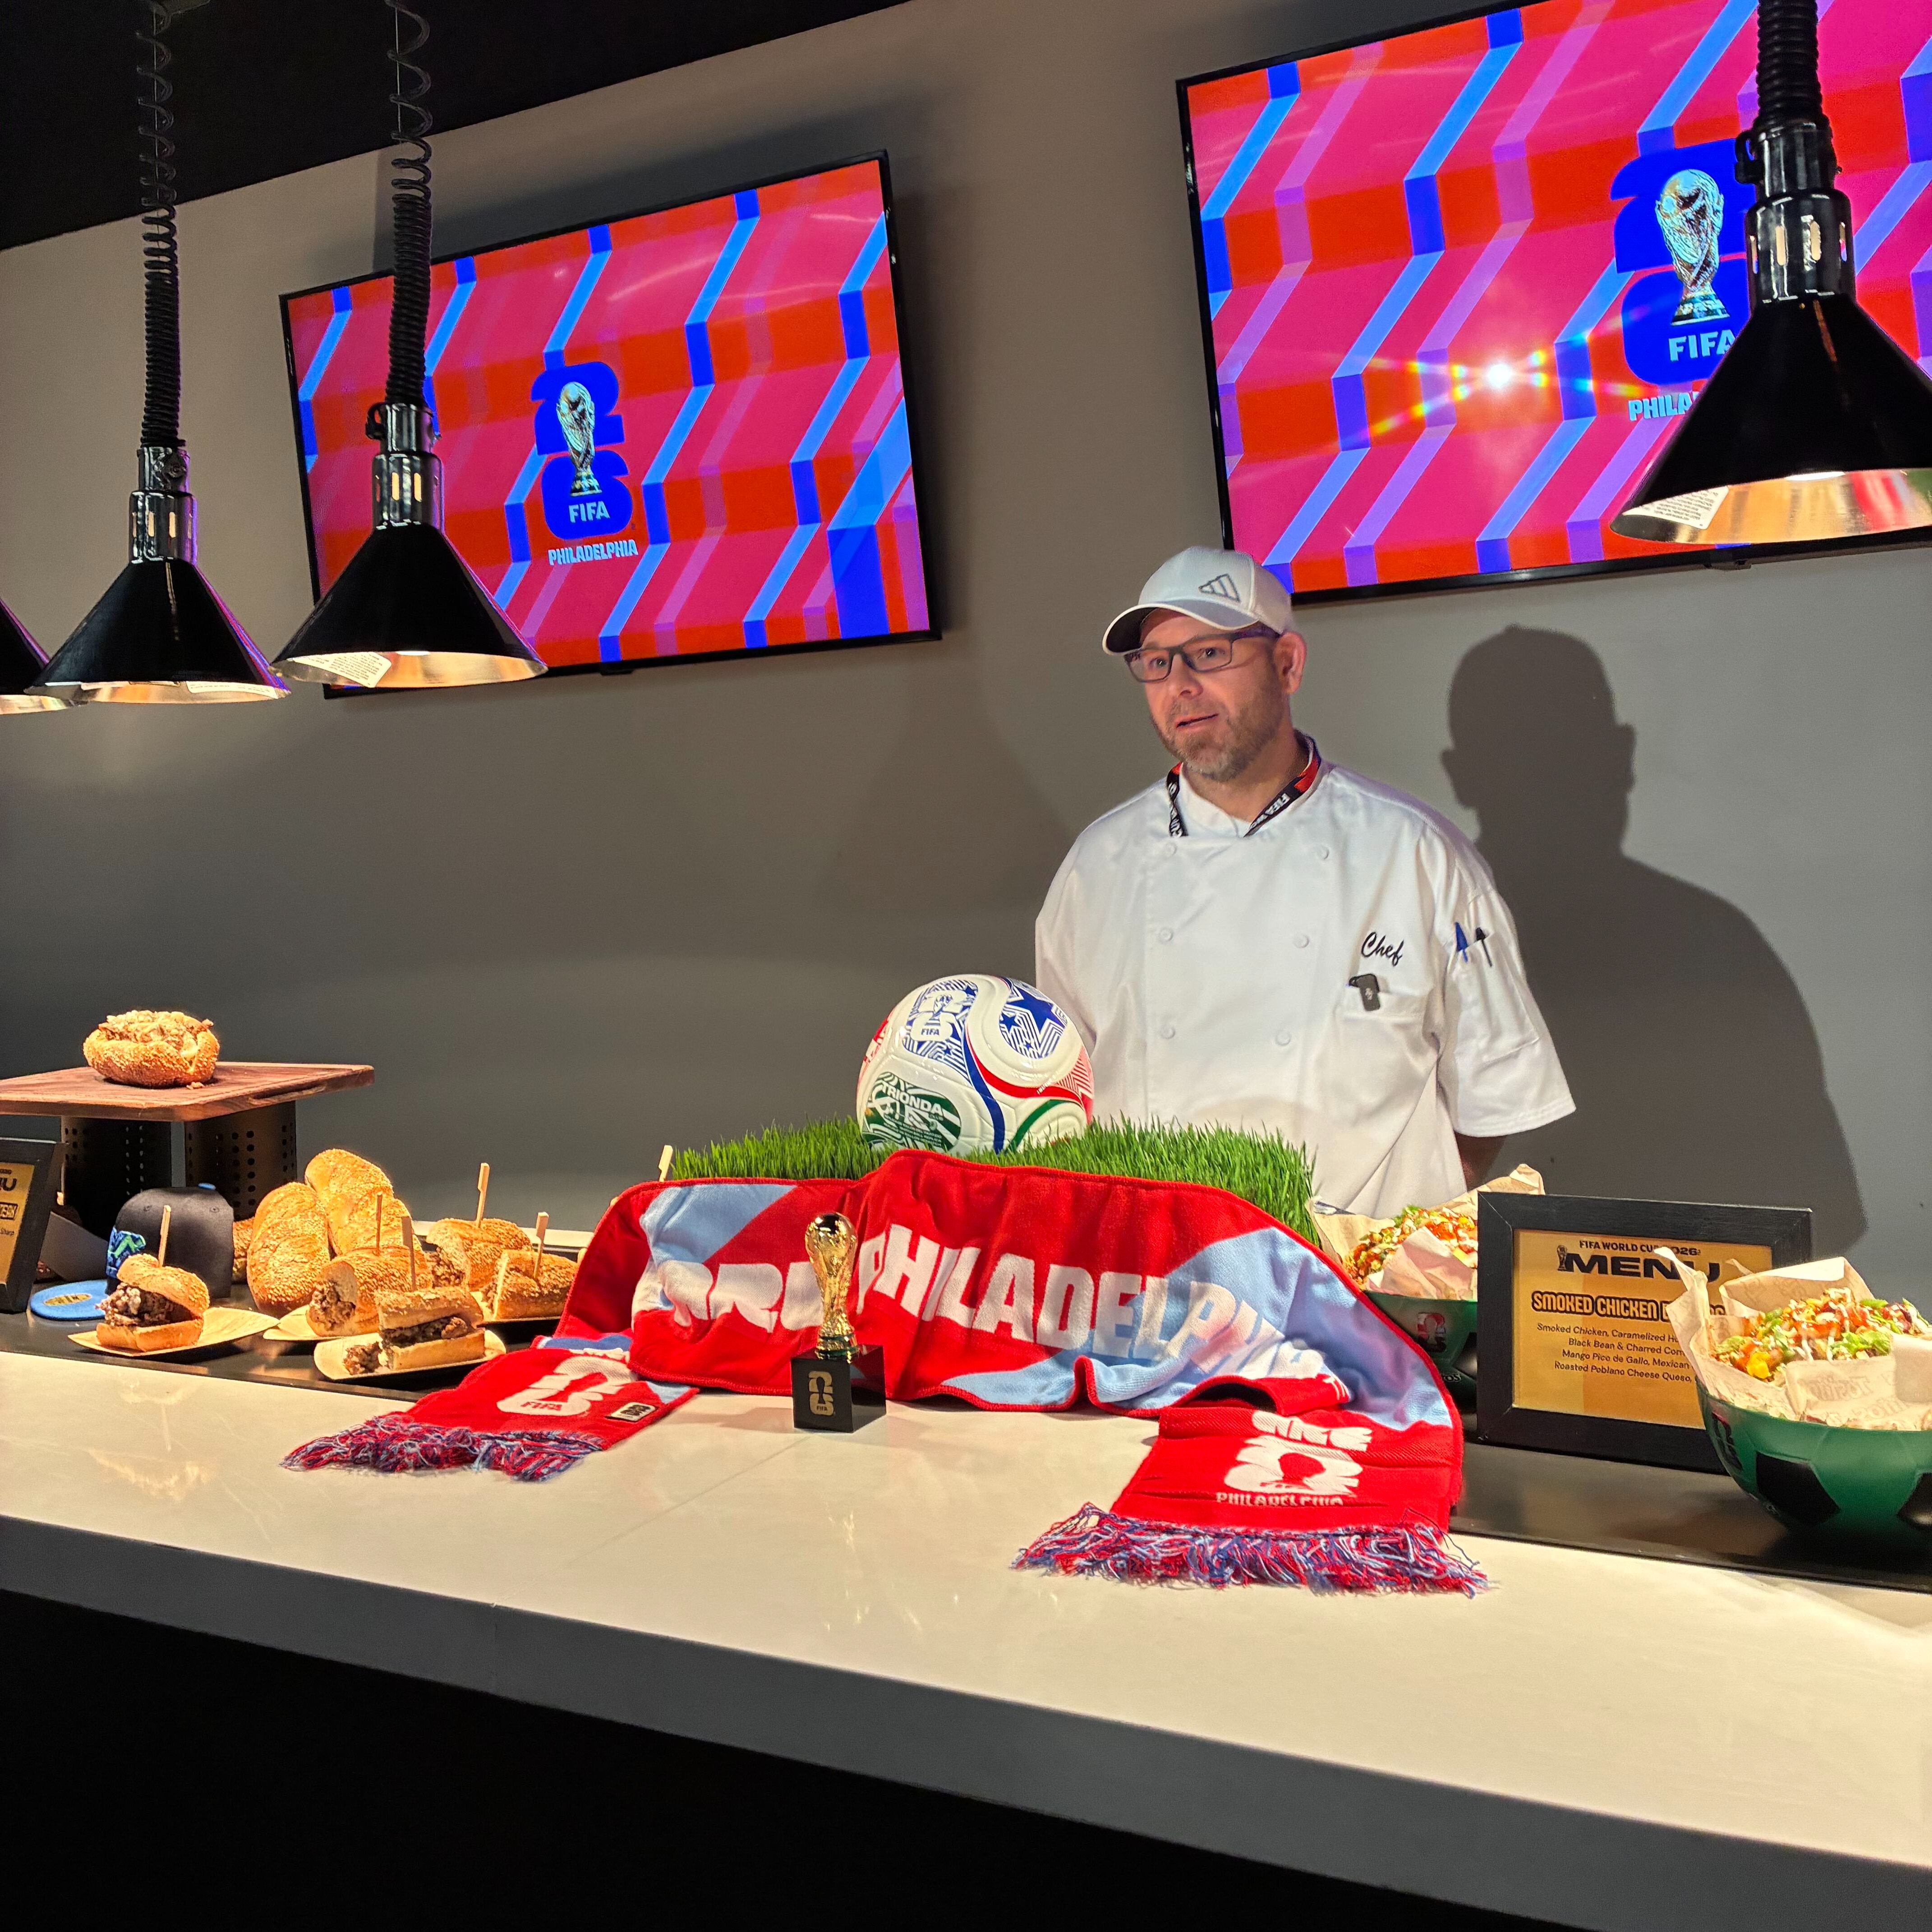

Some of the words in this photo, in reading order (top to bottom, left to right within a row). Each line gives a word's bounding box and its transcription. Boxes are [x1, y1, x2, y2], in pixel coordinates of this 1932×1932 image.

[1669, 329, 1736, 362] FIFA
[569, 501, 610, 523] FIFA
[548, 539, 639, 566] PHILADELPHIA
[1361, 932, 1404, 966] Chef
[921, 1028, 939, 1036] FIFA
[882, 1081, 944, 1116] TRIONDA
[1579, 1240, 1601, 1250] FIFA
[1602, 1242, 1638, 1252] WORLD
[1670, 1247, 1698, 1256] 026
[1532, 1292, 1593, 1313] SMOKED
[1596, 1297, 1659, 1320] CHICKEN
[1537, 1323, 1571, 1334] Smoked
[1611, 1329, 1665, 1341] Caramelized
[1569, 1338, 1591, 1348] Black
[1593, 1340, 1615, 1350] Bean
[1617, 1342, 1624, 1350] &
[1626, 1343, 1661, 1354] Charred
[1562, 1349, 1590, 1361] Mango
[1592, 1353, 1610, 1362] Pico
[1613, 1355, 1624, 1363] de
[1626, 1356, 1650, 1366] Gallo,
[1652, 1358, 1690, 1369] Mexican
[1554, 1361, 1589, 1372] Roasted
[1591, 1365, 1625, 1375] Poblano
[1627, 1368, 1660, 1379] Cheese
[1662, 1372, 1692, 1383] Queso,
